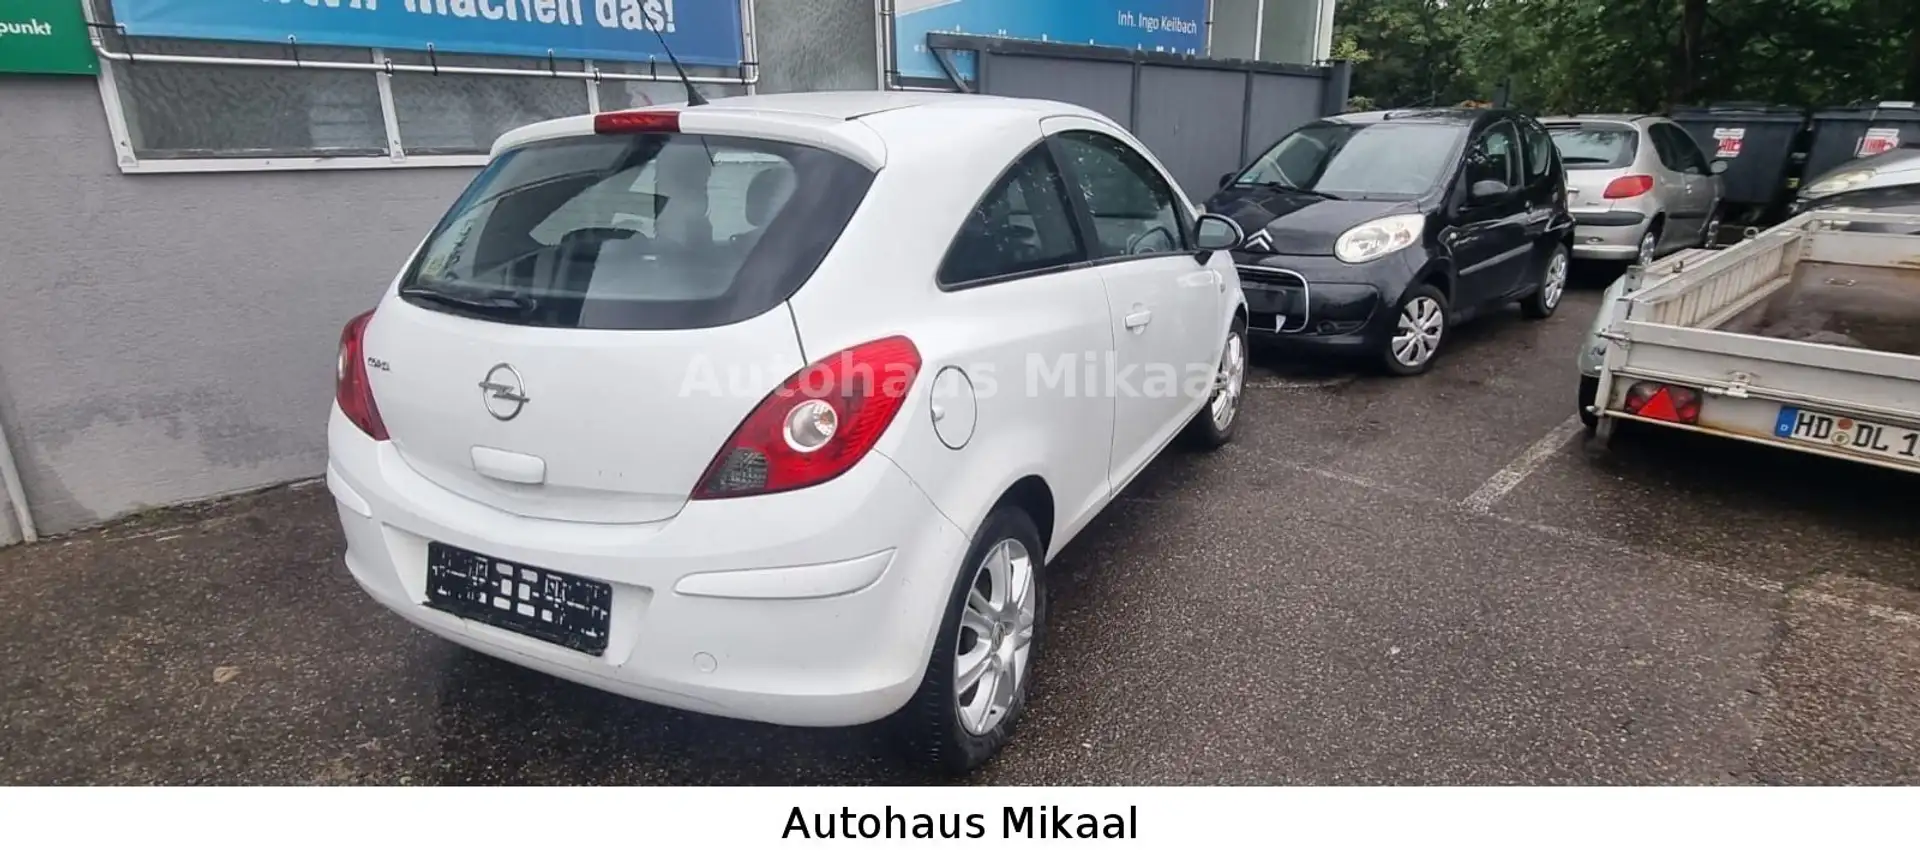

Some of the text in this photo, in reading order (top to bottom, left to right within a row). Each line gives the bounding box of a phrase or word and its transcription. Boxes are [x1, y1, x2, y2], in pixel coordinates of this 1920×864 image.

[596, 0, 676, 32] das!
[1118, 10, 1136, 27] Inh.
[1138, 12, 1159, 32] Ingo
[1794, 413, 1833, 439] HD
[1852, 423, 1889, 451] DL
